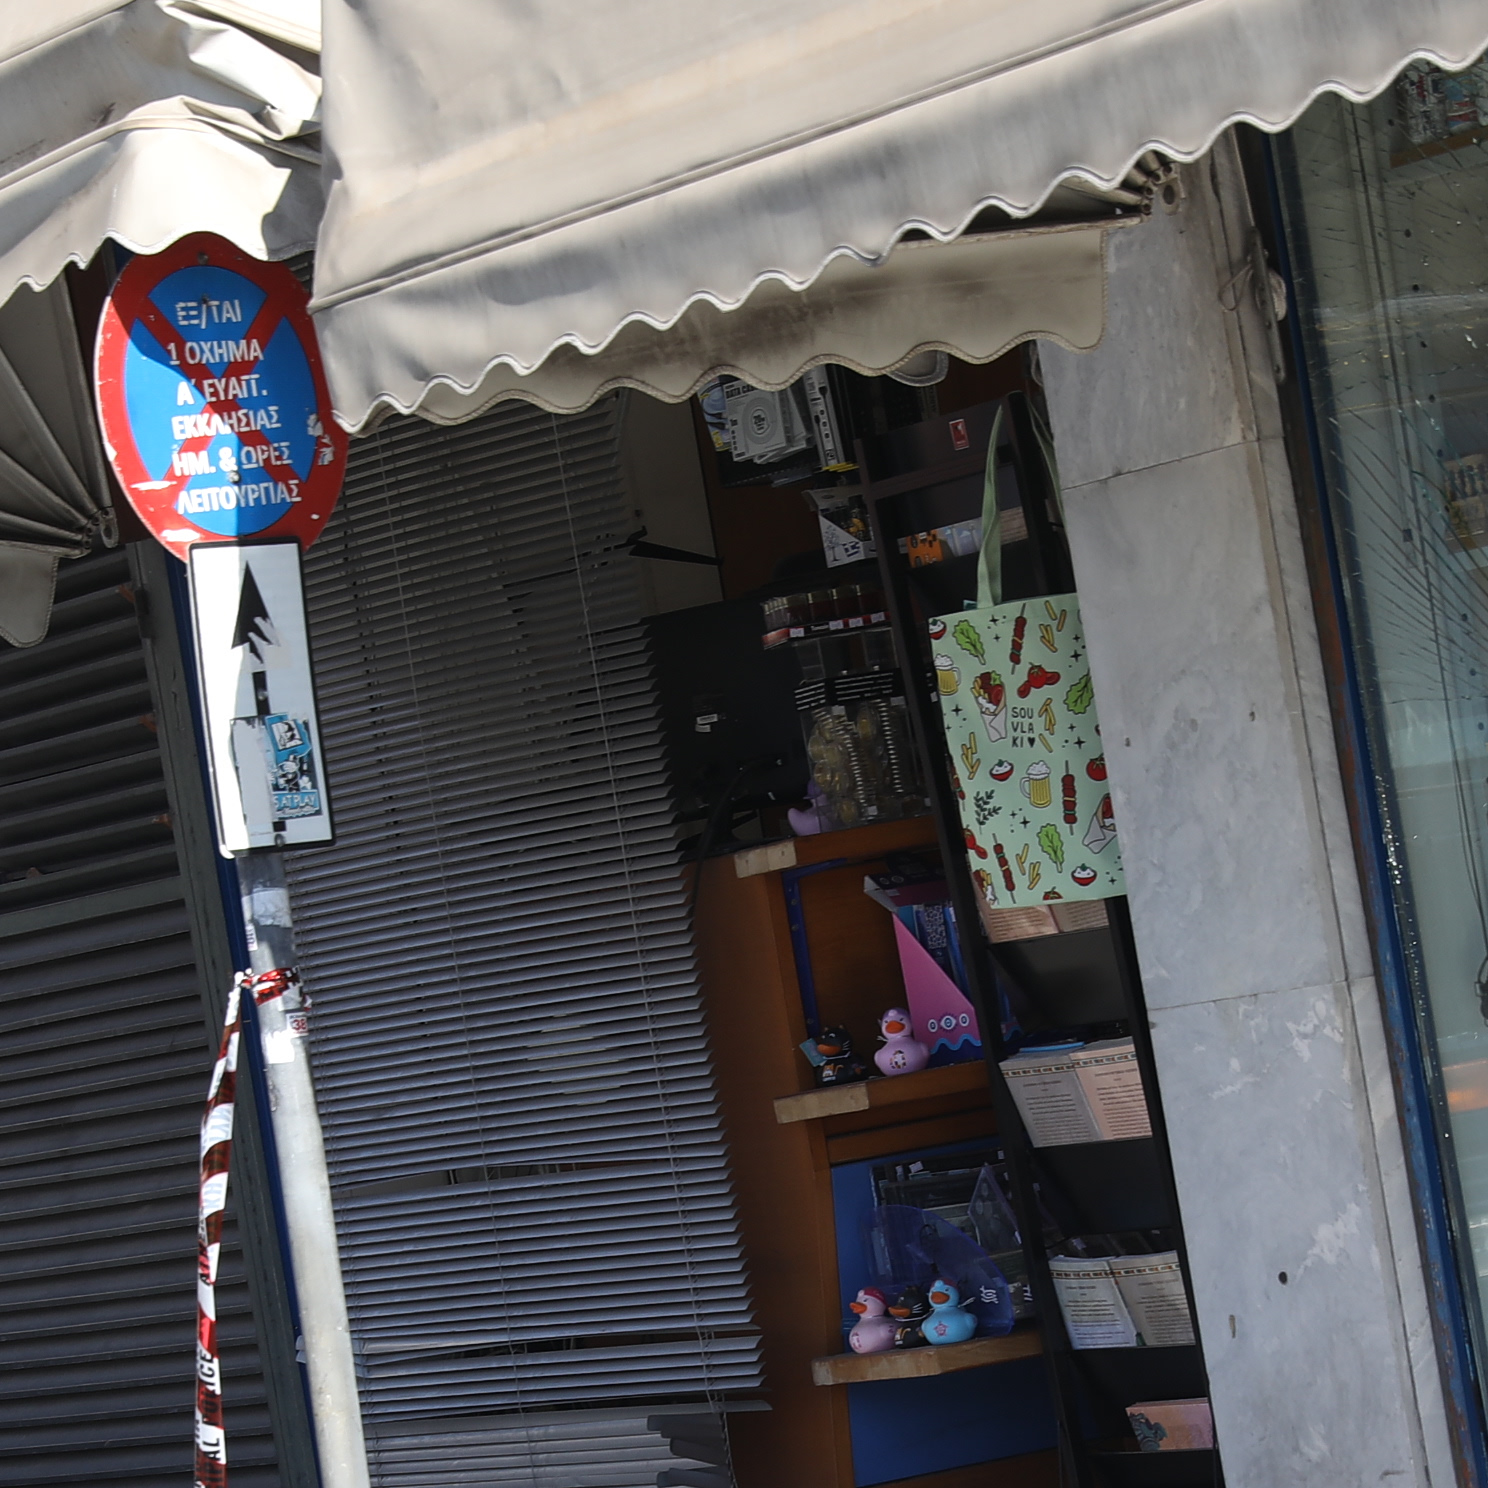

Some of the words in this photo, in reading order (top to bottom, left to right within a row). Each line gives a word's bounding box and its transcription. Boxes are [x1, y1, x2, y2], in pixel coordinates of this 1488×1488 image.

[167, 342, 180, 365] 1
[185, 339, 264, 365] ΟΧΗΜΑ
[171, 405, 282, 440] ΕΚΚΛΗΣΙΑΣ
[219, 446, 238, 473] &
[241, 442, 294, 470] ΩΡΕΣ
[177, 480, 302, 515] ΛΕΙΤΟΥΡΓΙΑΣ
[1011, 706, 1034, 719] SOU
[1011, 721, 1034, 734] VLA
[1011, 735, 1024, 748] KI
